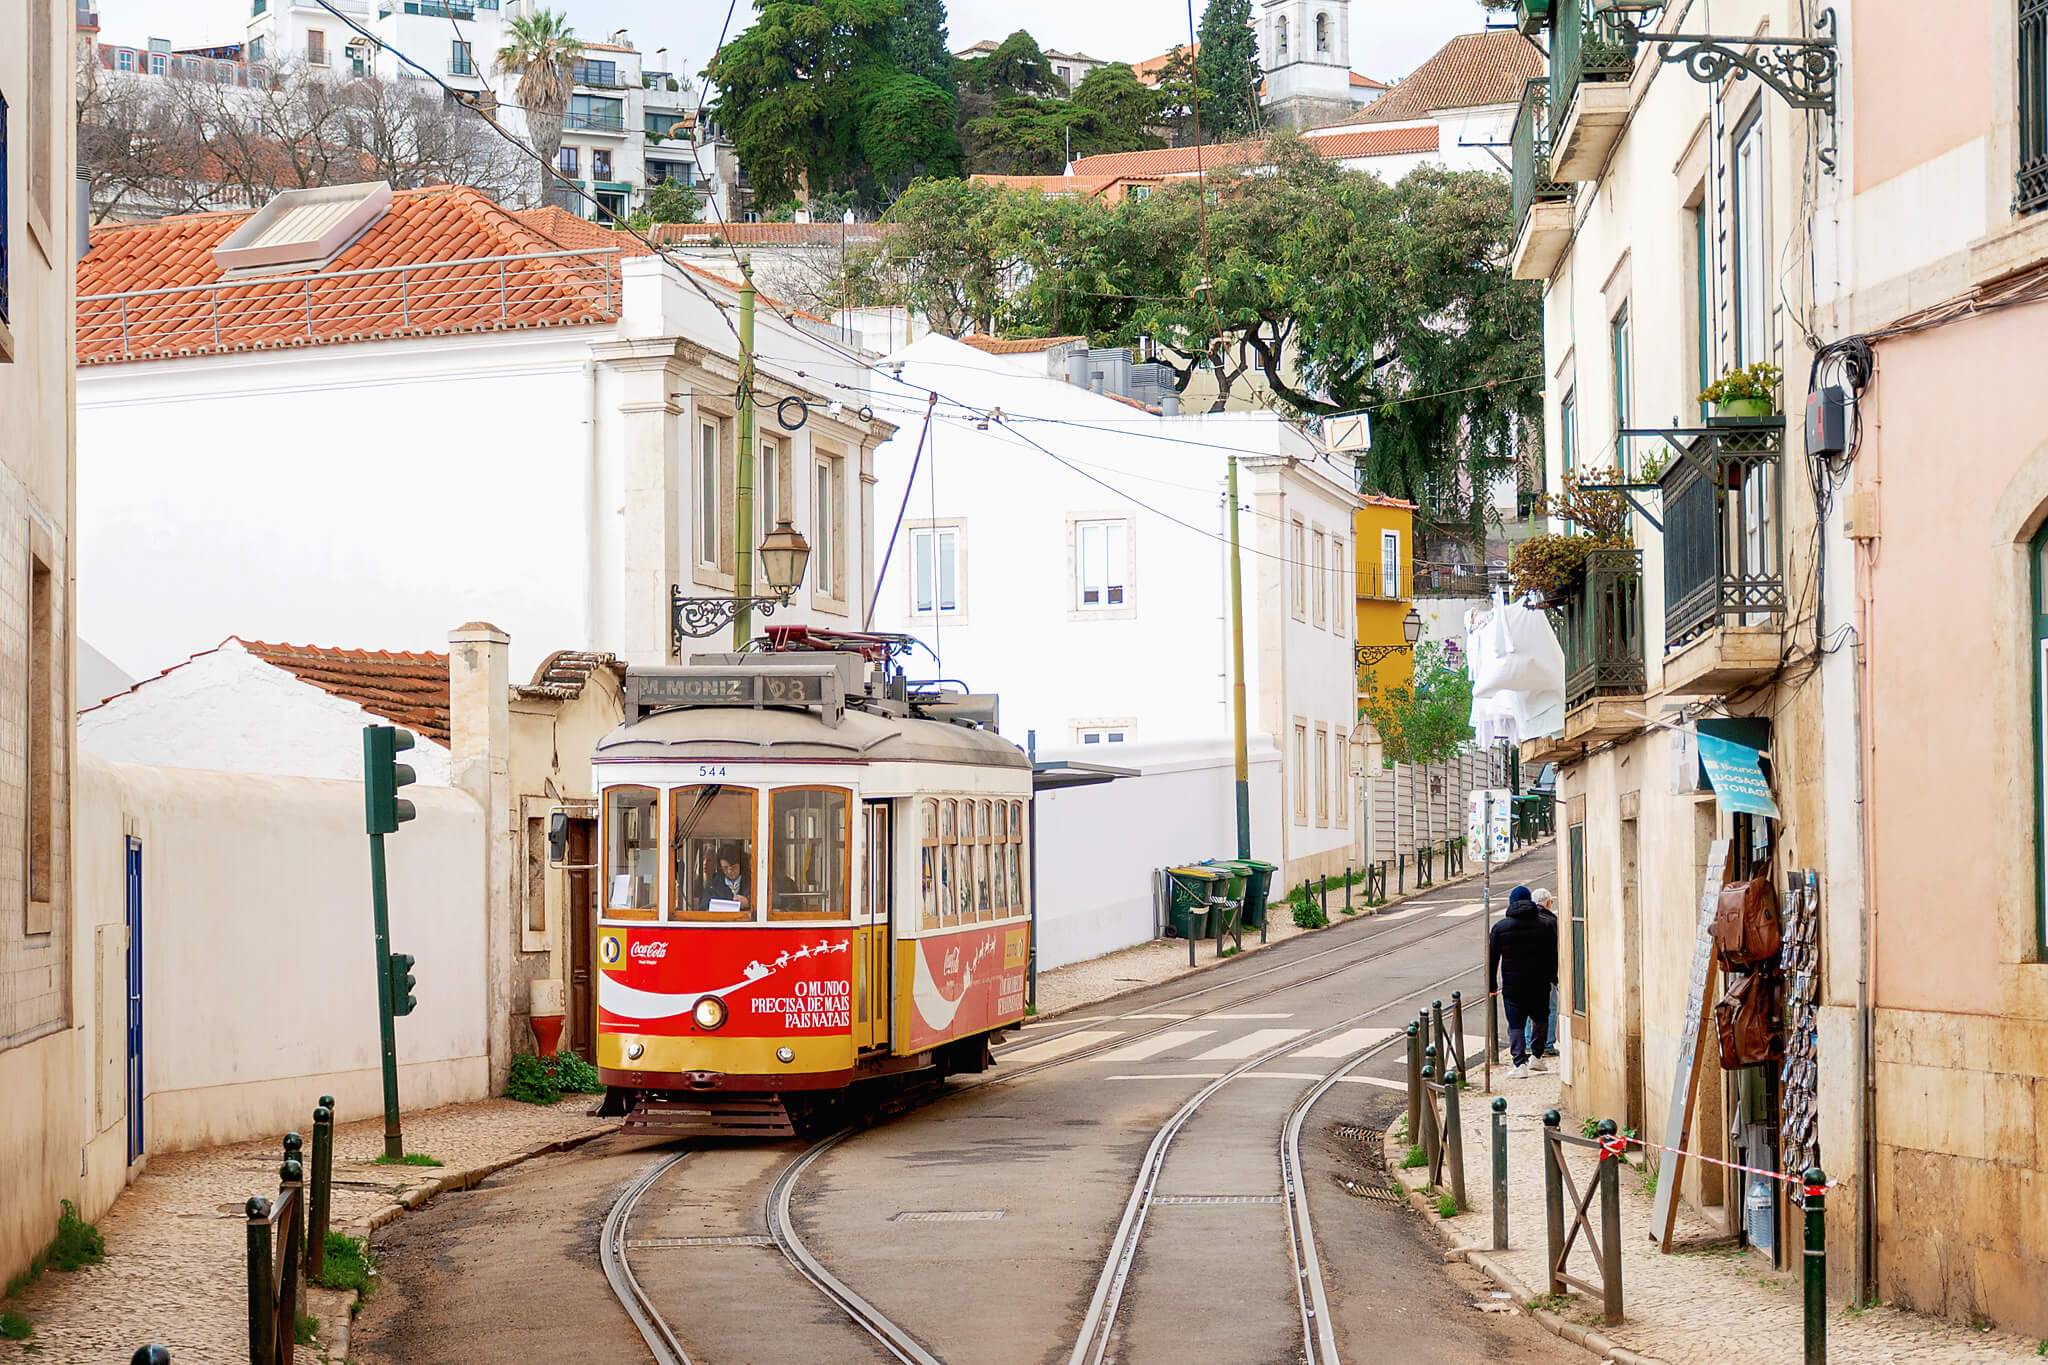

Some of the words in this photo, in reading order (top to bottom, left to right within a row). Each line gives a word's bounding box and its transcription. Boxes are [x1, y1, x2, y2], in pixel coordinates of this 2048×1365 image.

[641, 679, 743, 696] M.MONIZ
[699, 765, 727, 777] 544
[794, 981, 808, 997] O
[808, 980, 850, 996] MUNDO
[751, 998, 806, 1013] PRECISA
[807, 997, 824, 1012] DE
[824, 996, 850, 1012] MAIS
[785, 1013, 811, 1029] PAIS
[811, 1012, 850, 1027] NATAIS
